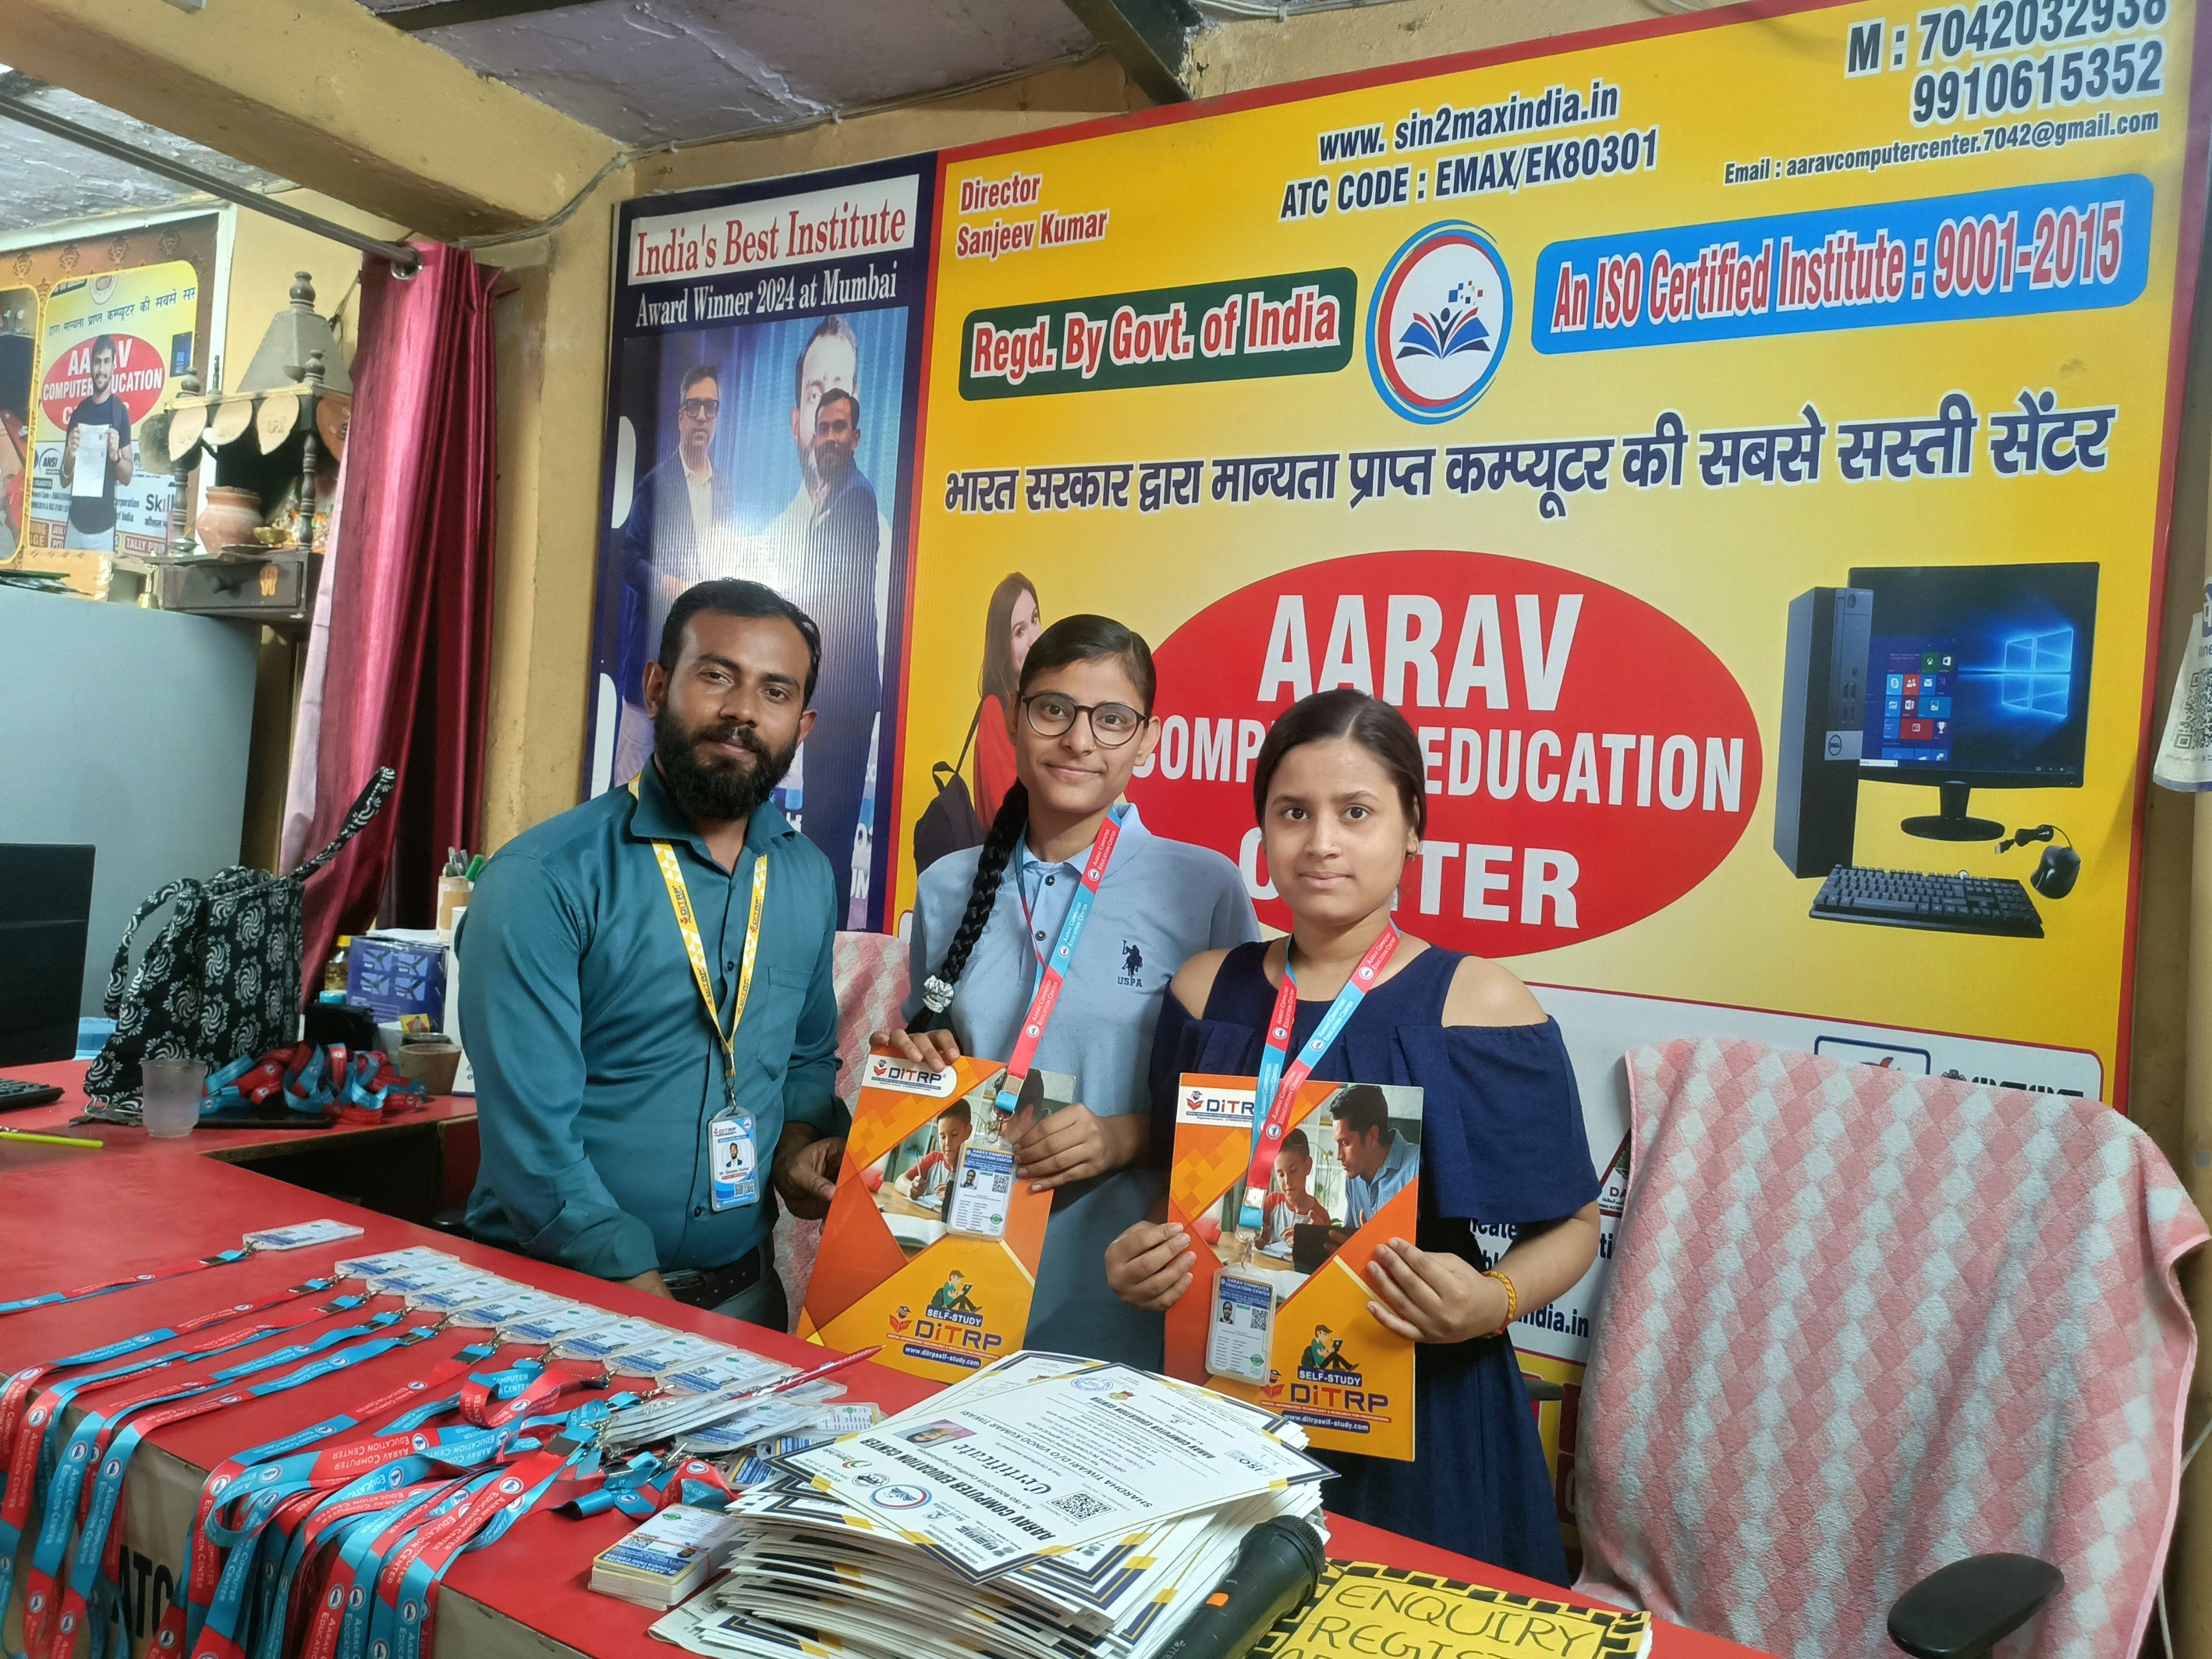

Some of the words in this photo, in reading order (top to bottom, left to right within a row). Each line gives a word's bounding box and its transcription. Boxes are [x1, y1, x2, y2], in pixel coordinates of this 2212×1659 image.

[1850, 23, 1881, 74] M
[1913, 40, 2163, 123] 9910615352
[1319, 127, 1385, 161] www.
[1395, 82, 1618, 149] sin2maxindia.in
[1725, 159, 1770, 184] Email
[1787, 112, 2158, 176] aaravcomputercenter.7042@gmail.com
[1280, 180, 1328, 218] ATC
[1337, 166, 1409, 210] CODE
[1437, 129, 1656, 196] EMAX/EK80301
[961, 174, 1041, 212] Director
[636, 225, 717, 276] India's
[723, 217, 779, 265] Best
[786, 199, 906, 257] Institute
[957, 224, 1034, 259] Sanjeev
[1041, 211, 1107, 244] Kumar
[1553, 267, 1586, 328] An
[1597, 257, 1641, 326] ISO
[1651, 245, 1770, 320] Certified
[1778, 234, 1902, 309] Institute
[1936, 206, 2121, 296] 9001-2015
[635, 289, 688, 327] Award
[693, 284, 754, 319] Winner
[757, 276, 795, 314] 2024
[800, 276, 817, 308] at
[821, 260, 898, 306] Mumbai
[974, 322, 1055, 380] Regd.
[1066, 317, 1103, 373] By
[1113, 307, 1191, 361] Govt.
[1204, 299, 1238, 353] of
[1248, 291, 1336, 347] India
[43, 377, 93, 401] COMPUTER
[110, 367, 163, 394] UCATION
[946, 469, 1020, 512] भारत
[1026, 464, 1133, 510] सरकार
[1140, 460, 1204, 512] द्वारा
[1213, 453, 1339, 502] मान्यता
[1349, 450, 1436, 509] प्राप्त
[1446, 439, 1614, 517] कम्प्यूटर
[1621, 411, 1688, 486] की
[1699, 403, 1825, 484] सबसे
[1838, 392, 1976, 480] सस्ती
[1990, 387, 2116, 475] सेंटर
[1258, 594, 1583, 711] AARAV
[1426, 727, 1744, 812] EDUCATION
[1239, 826, 1580, 928] CTER
[1117, 977, 1142, 988] USPA
[1207, 1099, 1255, 1115] DiTR
[971, 1152, 996, 1161] EDUCATION
[1225, 1283, 1252, 1292] EDUCATION
[1243, 1282, 1270, 1291] COMPUTER
[927, 1308, 982, 1327] SELF-STUDY
[915, 1319, 1002, 1351] DiTRP
[905, 1346, 980, 1367] www.ditrpself-study.com
[1299, 1370, 1361, 1386] SELF-STUDY
[1088, 1396, 1118, 1408] CENTER
[1290, 1383, 1389, 1413] DiTRP
[958, 1410, 993, 1424] TIWARI
[1113, 1407, 1154, 1426] EDUCATION
[1283, 1413, 1369, 1431] www.ditrpself-study.com
[987, 1423, 1024, 1438] KUMAR
[1148, 1425, 1192, 1446] COMPUTER
[332, 1447, 365, 1459] CENTER
[368, 1436, 409, 1452] EDUCATION
[383, 1448, 409, 1460] AARAV
[466, 1446, 493, 1459] AARAV
[858, 1437, 905, 1457] CENTER
[1019, 1437, 1053, 1452] VINOD
[1186, 1444, 1217, 1459] AARAV
[334, 1454, 380, 1470] COMPUTER
[893, 1454, 958, 1484] EDUCATION
[947, 1443, 1056, 1496] Certificate
[1067, 1461, 1107, 1480] TIWARI
[1235, 1458, 1265, 1472] ISO
[947, 1481, 1018, 1517] COMPUTER
[1100, 1479, 1155, 1507] SHARDHA
[411, 1516, 457, 1547] EDUCATION
[1005, 1515, 1057, 1541] AARAV
[1334, 1584, 1596, 1657] ENQUIRY
